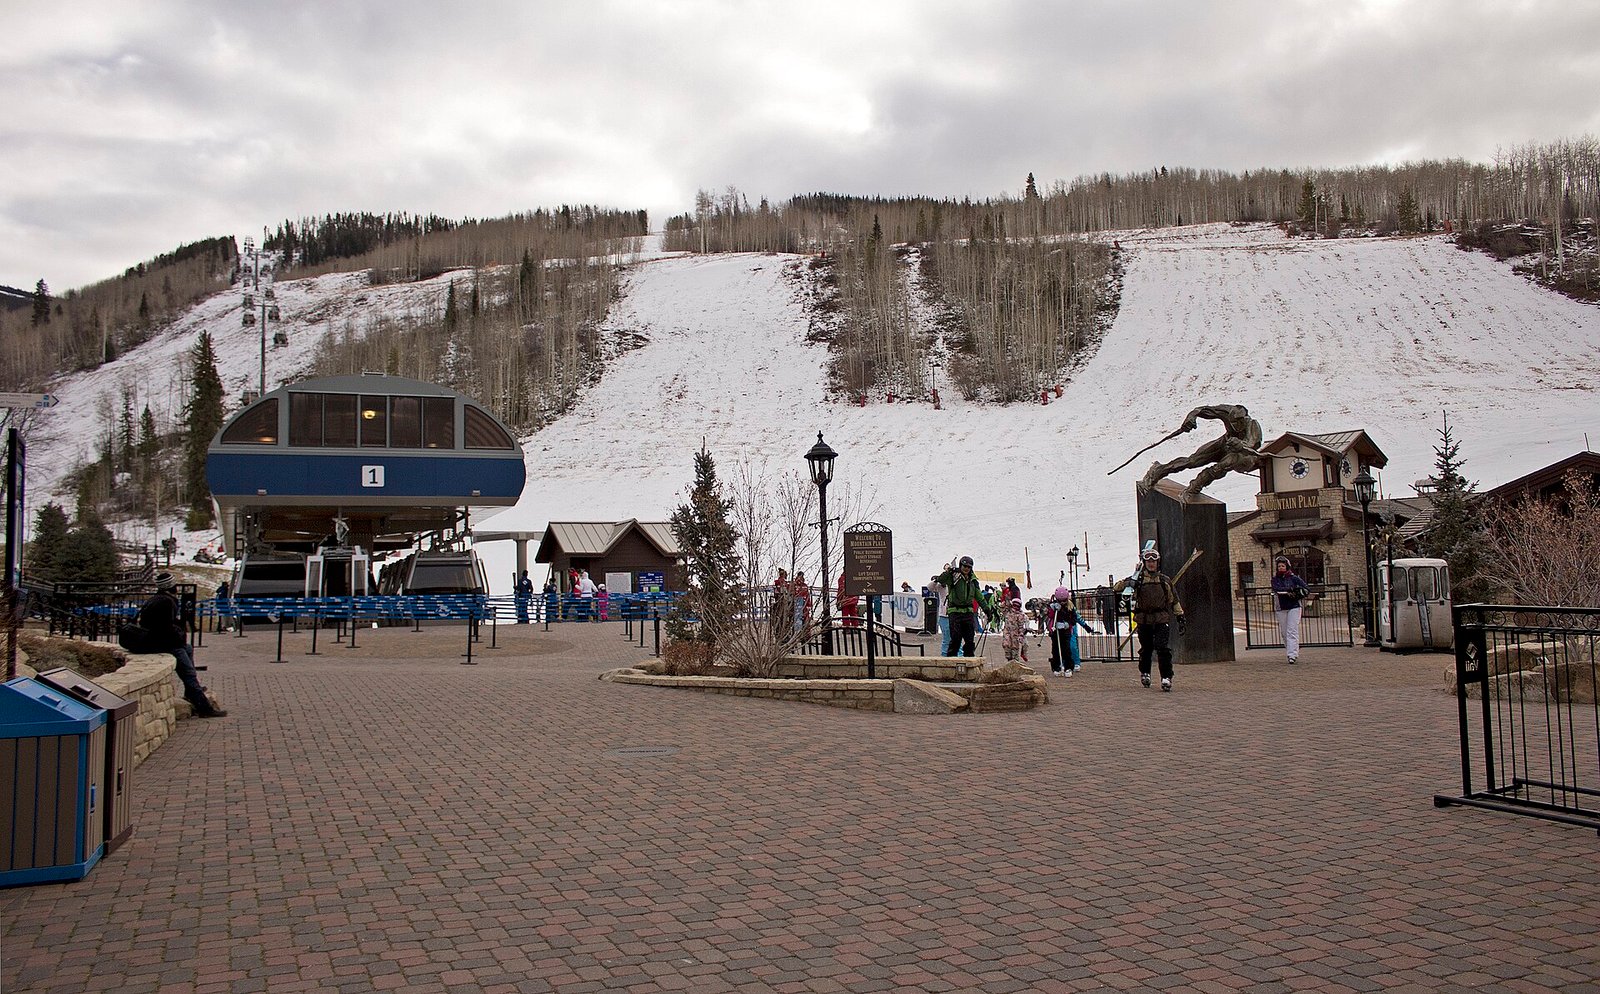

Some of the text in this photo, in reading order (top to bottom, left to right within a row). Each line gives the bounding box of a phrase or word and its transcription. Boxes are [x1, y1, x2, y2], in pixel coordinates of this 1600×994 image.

[368, 468, 378, 484] 1
[1264, 494, 1322, 511] MOUNTAIN PLAZA
